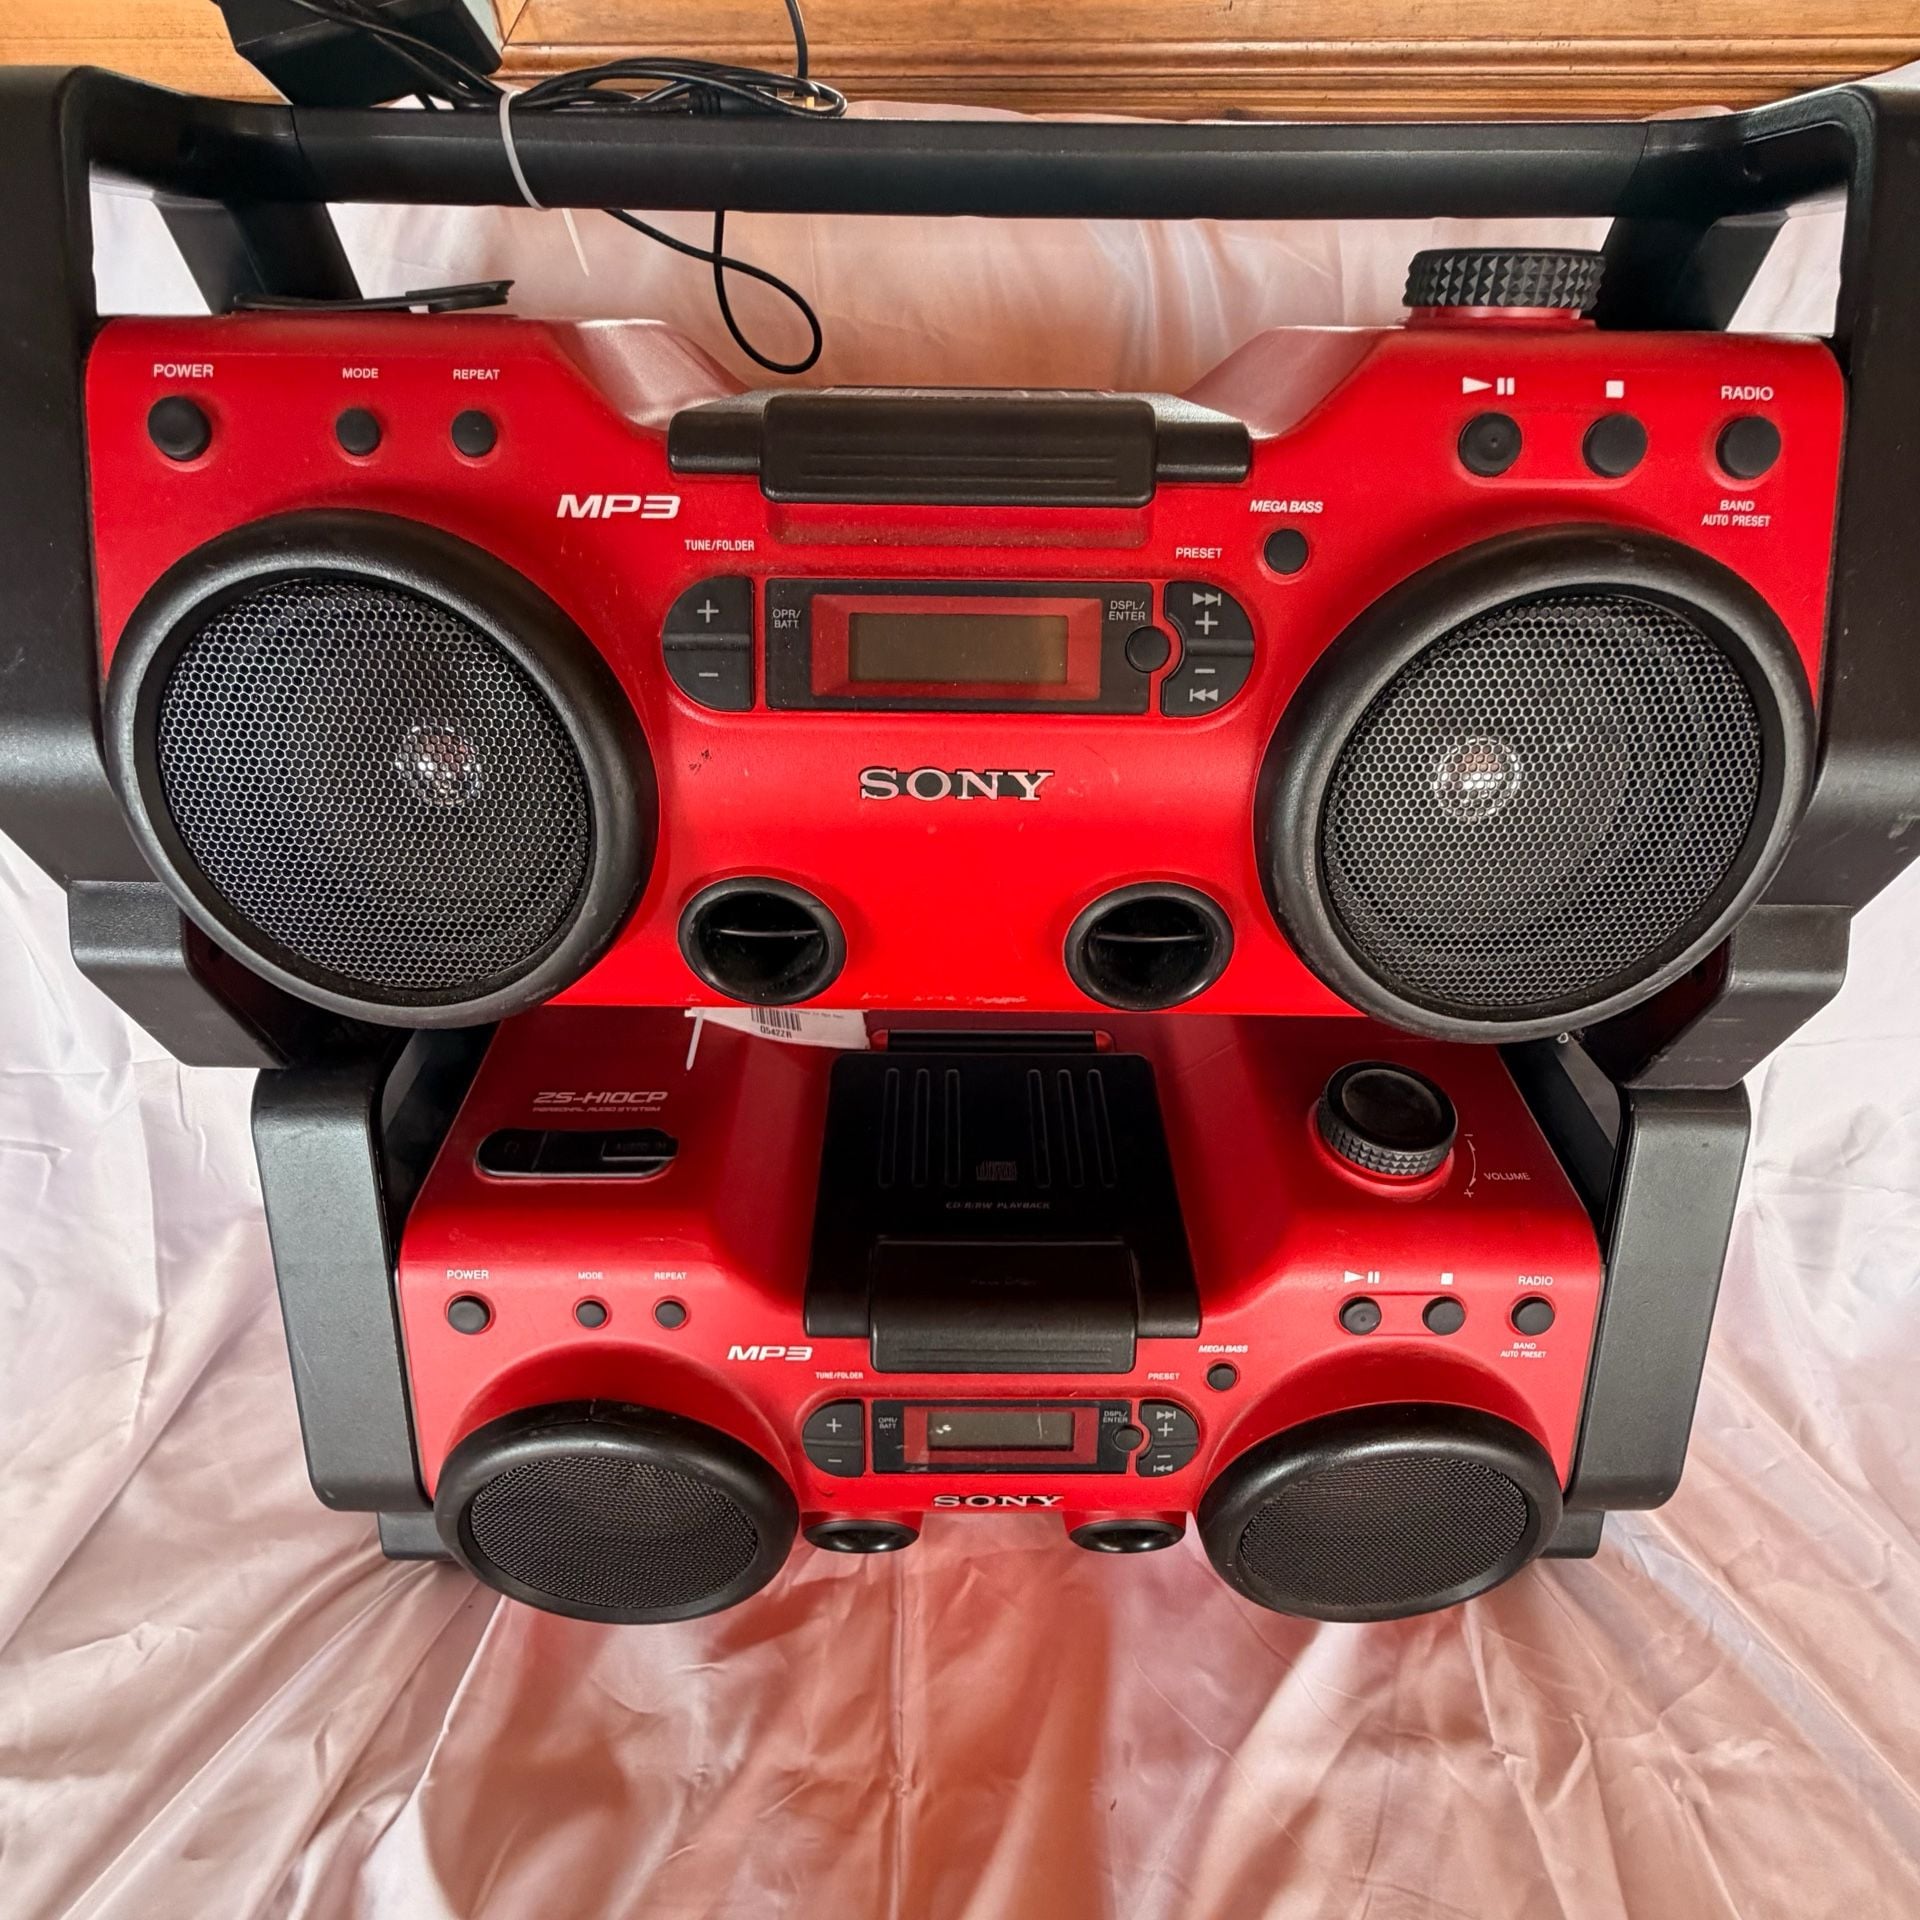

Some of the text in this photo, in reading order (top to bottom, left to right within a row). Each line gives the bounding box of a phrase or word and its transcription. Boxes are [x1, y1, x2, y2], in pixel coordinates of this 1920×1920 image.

[153, 363, 214, 378] POWER
[342, 367, 379, 379] MODE
[452, 368, 500, 380] REPEAT
[1720, 385, 1774, 401] RADIO
[556, 494, 681, 519] MP3
[1249, 499, 1324, 514] MEGA BASS
[1719, 499, 1755, 512] BAND
[1701, 513, 1771, 528] AUTO PRESET
[684, 539, 755, 552] TUNE/FOLDER
[1175, 546, 1223, 559] PRESET
[1109, 600, 1146, 611] DSPL/
[772, 609, 801, 619] OPR/
[1108, 610, 1146, 621] ENTER
[773, 619, 799, 629] BATT
[858, 768, 1054, 802] SONY
[1483, 1172, 1531, 1181] VOLUME
[446, 1269, 490, 1281] POWER
[577, 1271, 604, 1281] MODE
[653, 1271, 687, 1282] REPEAT
[1517, 1275, 1554, 1287] RADIO
[1198, 1344, 1249, 1353] MEGA BASS
[1513, 1342, 1537, 1350] BAND
[727, 1345, 813, 1361] MP3
[1500, 1350, 1547, 1359] AUTO PRESET
[815, 1371, 864, 1380] TUNE/FOLDER
[1147, 1372, 1180, 1381] PRESET
[878, 1422, 897, 1430] BATT
[933, 1495, 1064, 1508] SONY
